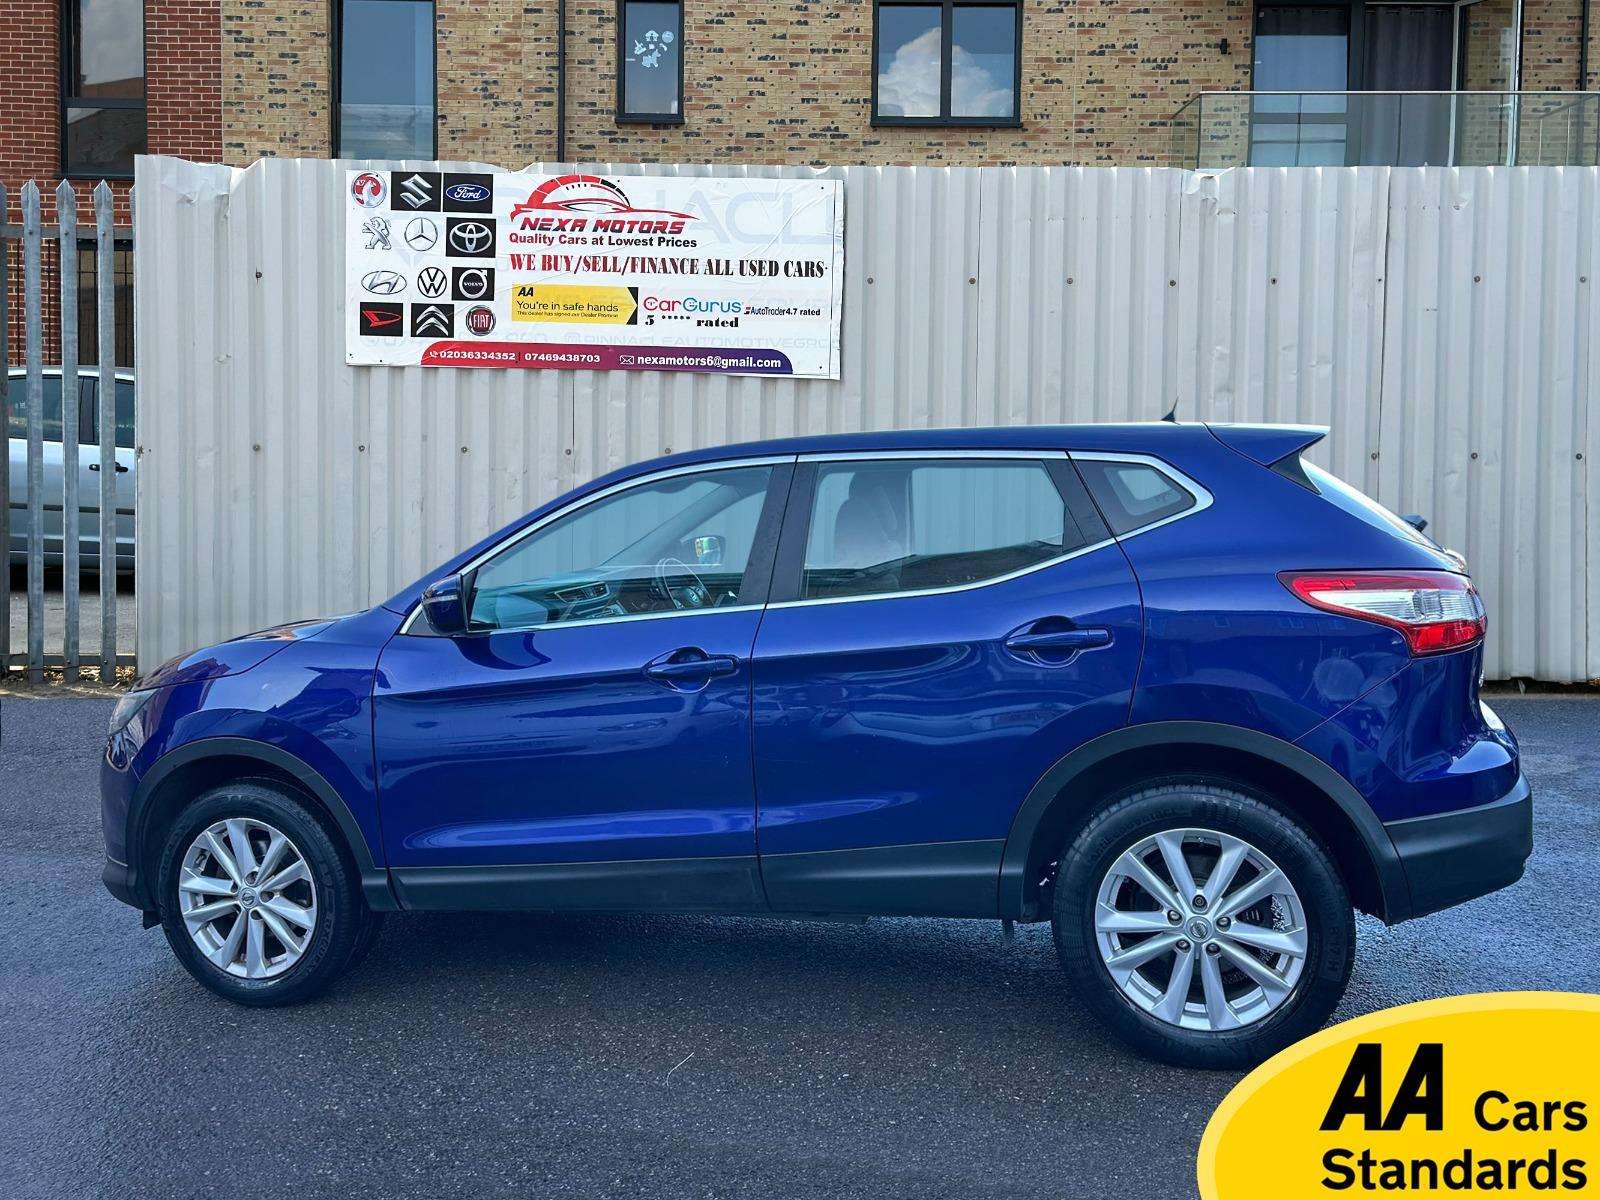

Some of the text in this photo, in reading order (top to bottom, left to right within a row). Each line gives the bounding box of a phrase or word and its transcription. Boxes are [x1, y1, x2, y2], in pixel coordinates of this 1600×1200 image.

[454, 186, 482, 199] Ford
[520, 217, 686, 235] NEXA MOTORS
[509, 232, 698, 248] Quality Cars at Lowest Prices
[510, 253, 825, 278] WE BUY/SELL/FINANCE ALL USED CARS
[517, 287, 534, 297] AA
[516, 300, 619, 312] You're in safe hands
[643, 297, 742, 313] CarGurus
[799, 308, 821, 316] rated
[472, 314, 489, 328] FIAT
[645, 315, 739, 328] 5 rated
[440, 351, 516, 360] 02036334352
[524, 353, 601, 363] 07469438703
[637, 355, 782, 369] nexamotors6@gmail.com
